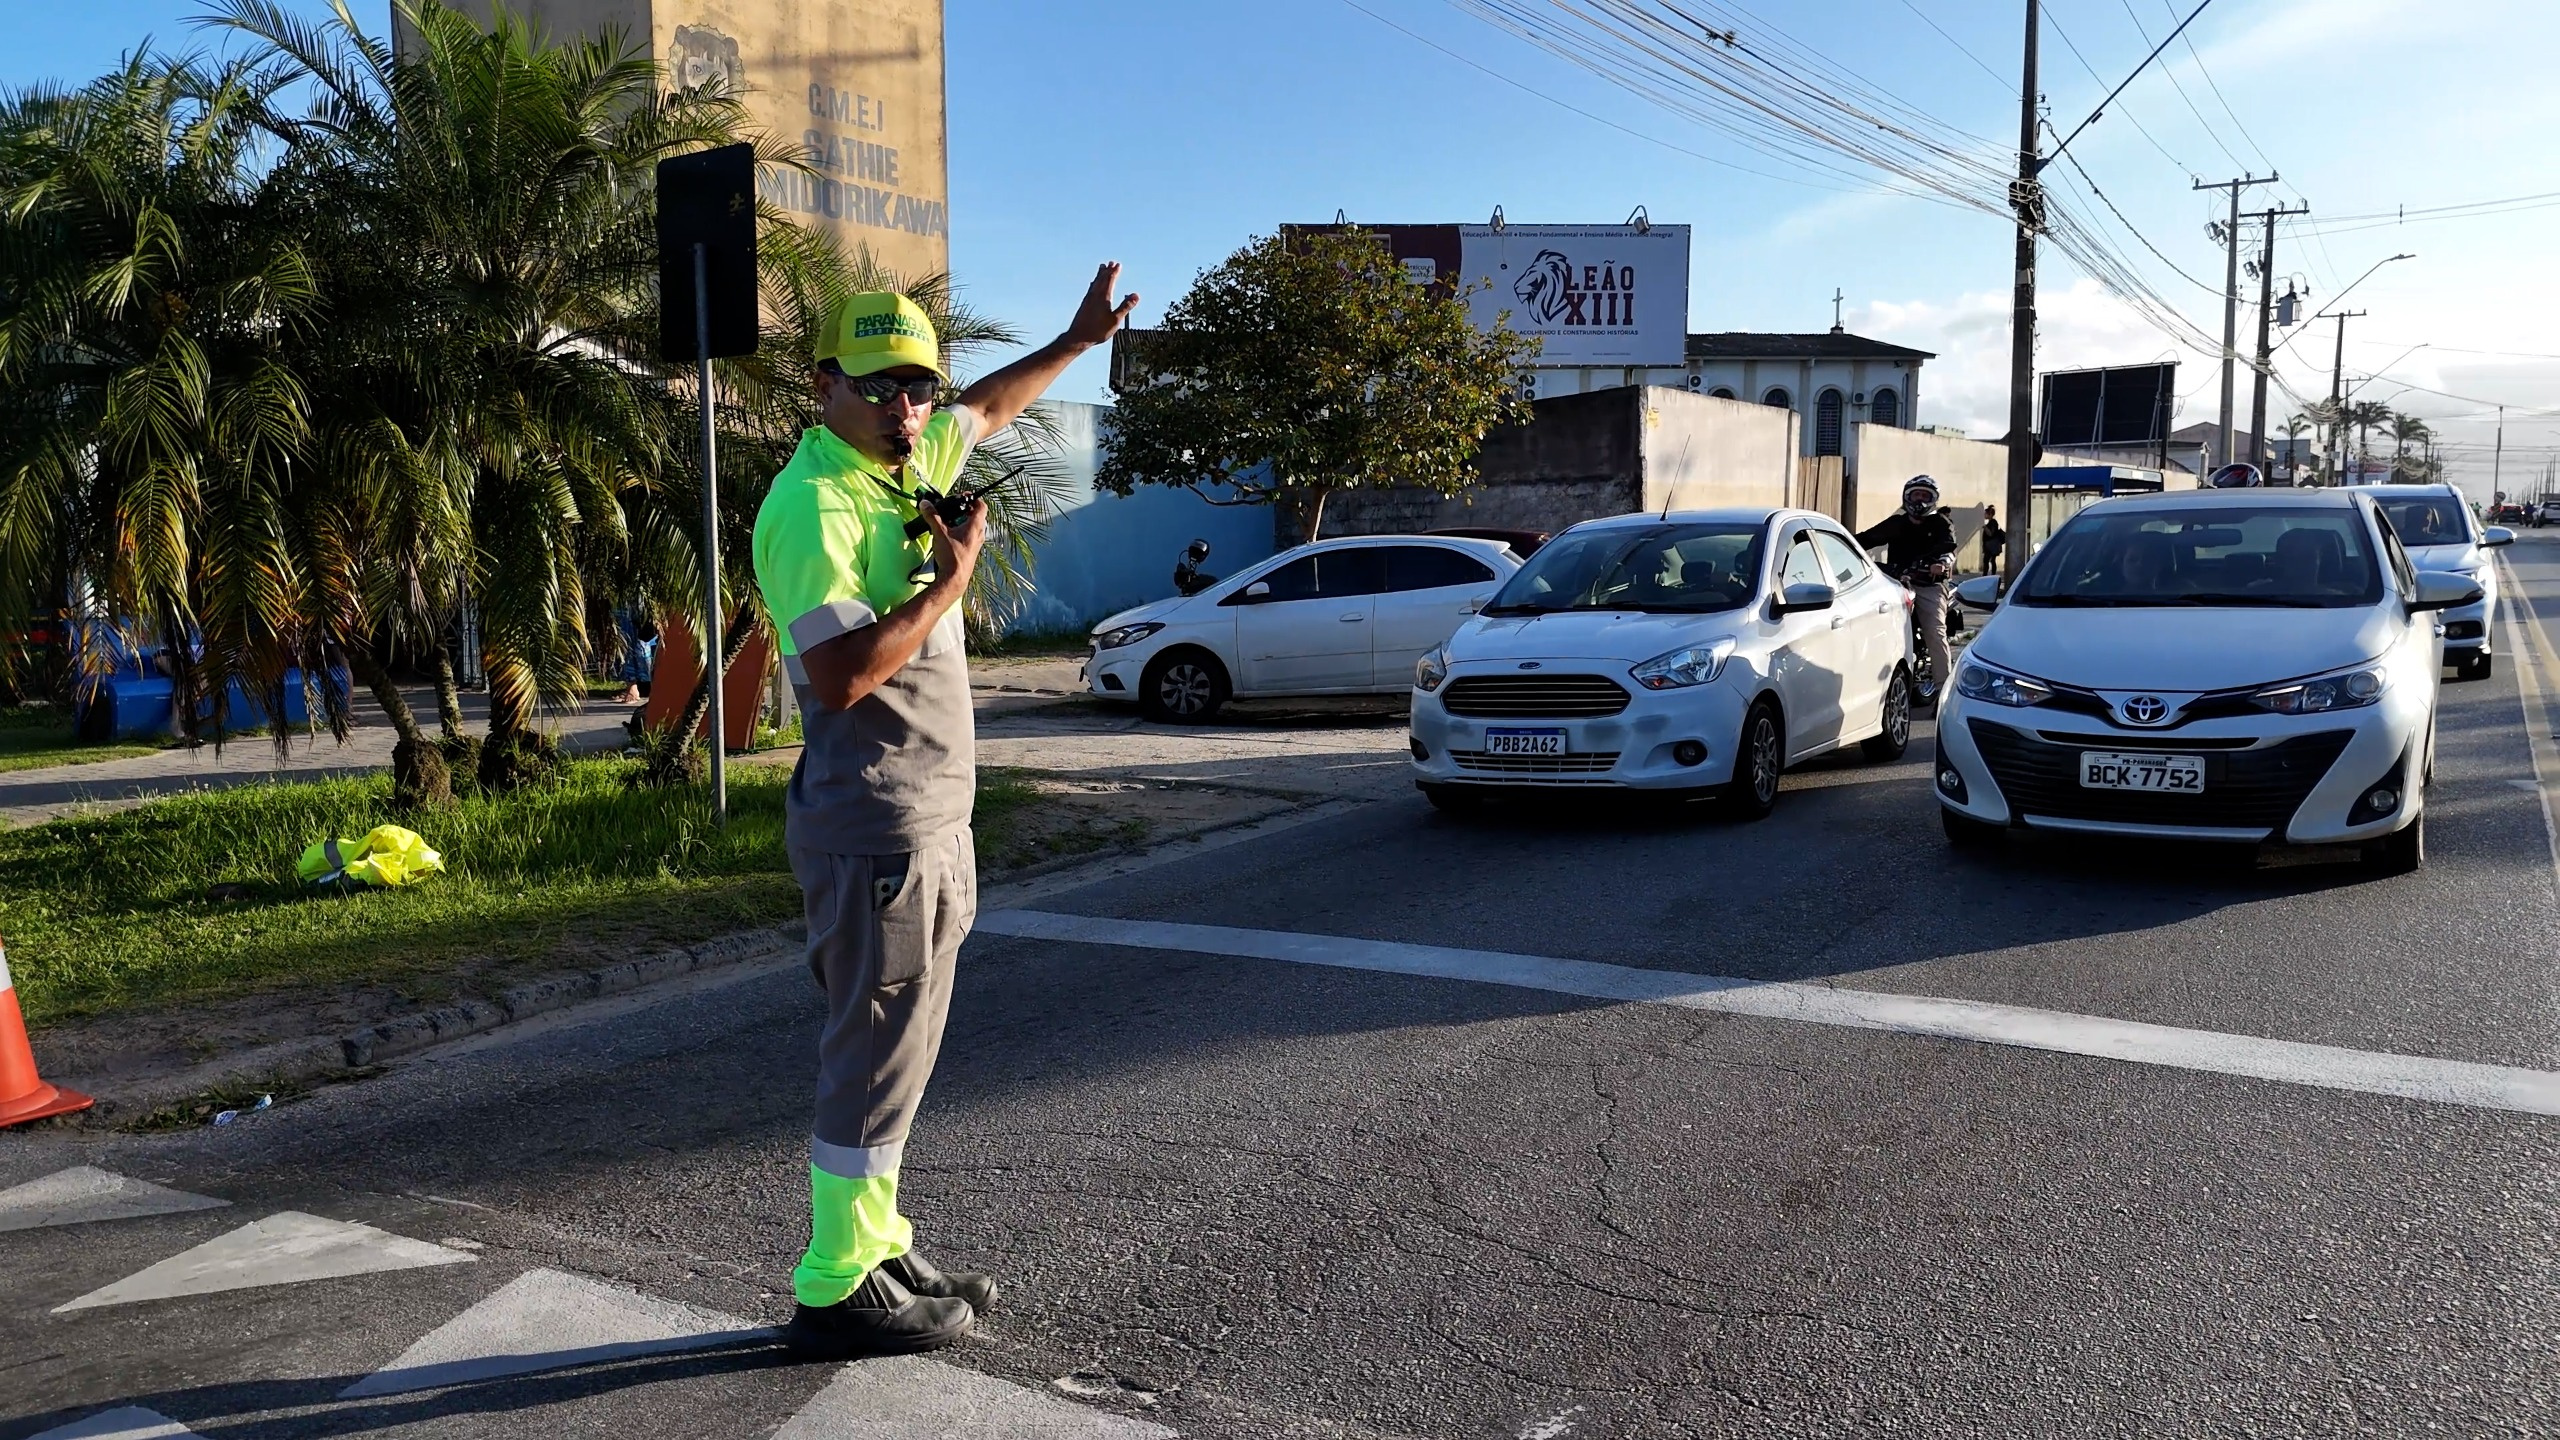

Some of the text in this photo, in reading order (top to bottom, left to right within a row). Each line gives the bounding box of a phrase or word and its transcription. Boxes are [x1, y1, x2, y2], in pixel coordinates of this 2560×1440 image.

[803, 128, 899, 187] SATHIE
[1462, 231, 1490, 239] Educação
[1564, 259, 1634, 291] LEÃO
[1564, 292, 1634, 326] XIII
[1493, 736, 1558, 753] PBB2A62
